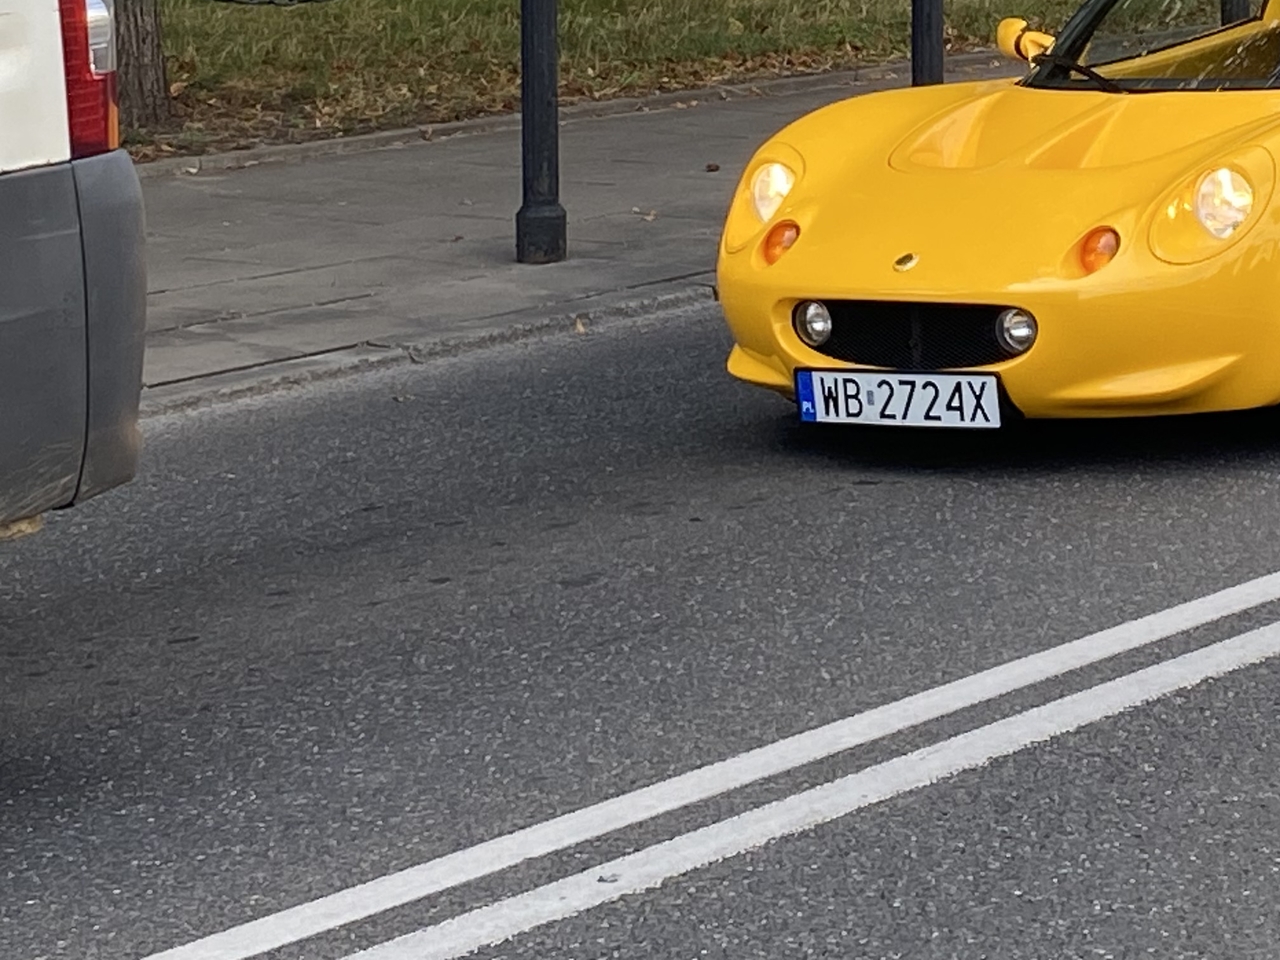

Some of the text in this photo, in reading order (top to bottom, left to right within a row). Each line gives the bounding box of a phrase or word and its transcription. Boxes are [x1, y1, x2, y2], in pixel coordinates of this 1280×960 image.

[802, 377, 991, 422] PL WB 2724X
